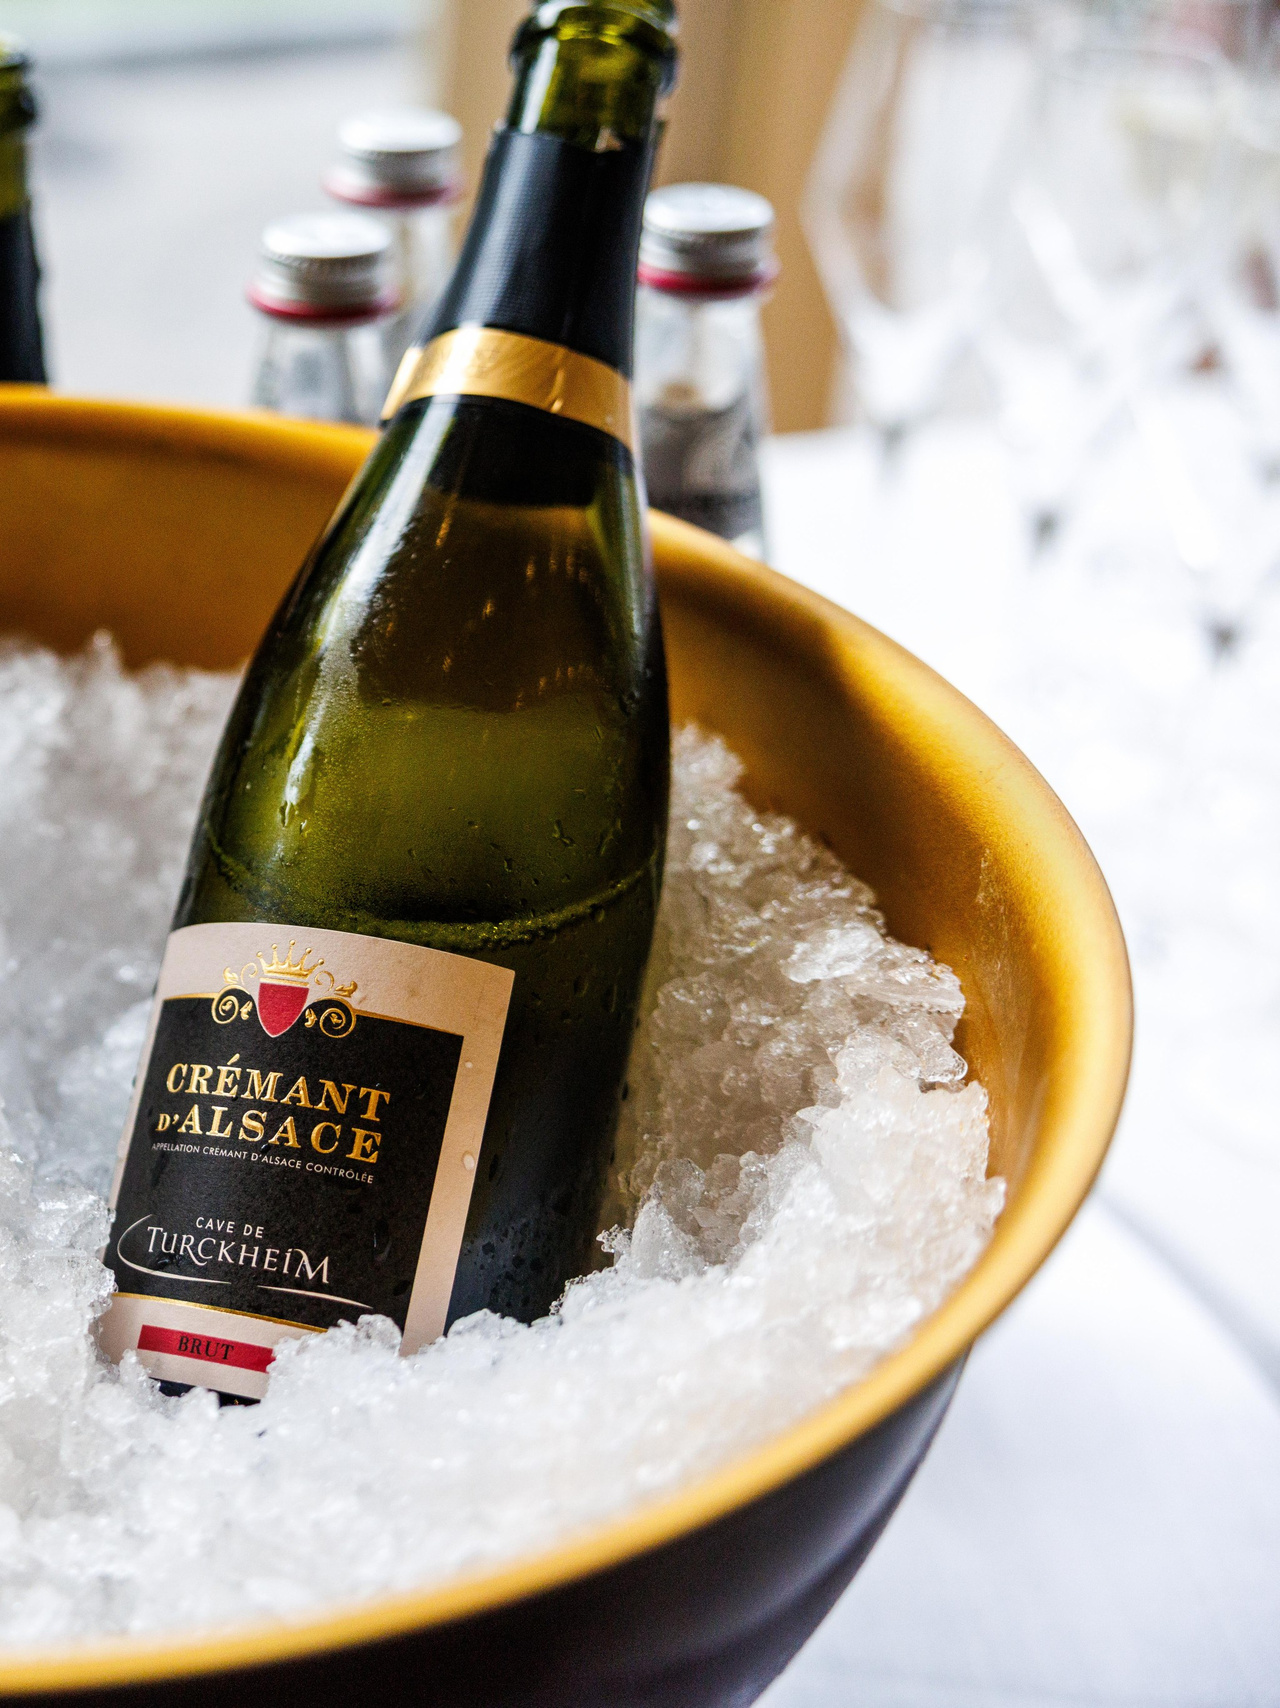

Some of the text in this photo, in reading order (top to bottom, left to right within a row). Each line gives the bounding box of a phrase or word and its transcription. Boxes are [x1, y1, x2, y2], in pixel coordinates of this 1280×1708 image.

[166, 1053, 390, 1121] CRÉMANT
[155, 1104, 382, 1163] D'ALSACE
[151, 1142, 374, 1184] APPELLATION CRÉMANT D'ALSACE CONTRÔLÉE
[196, 1216, 264, 1239] CAVE DE
[178, 1335, 234, 1361] BRUT
